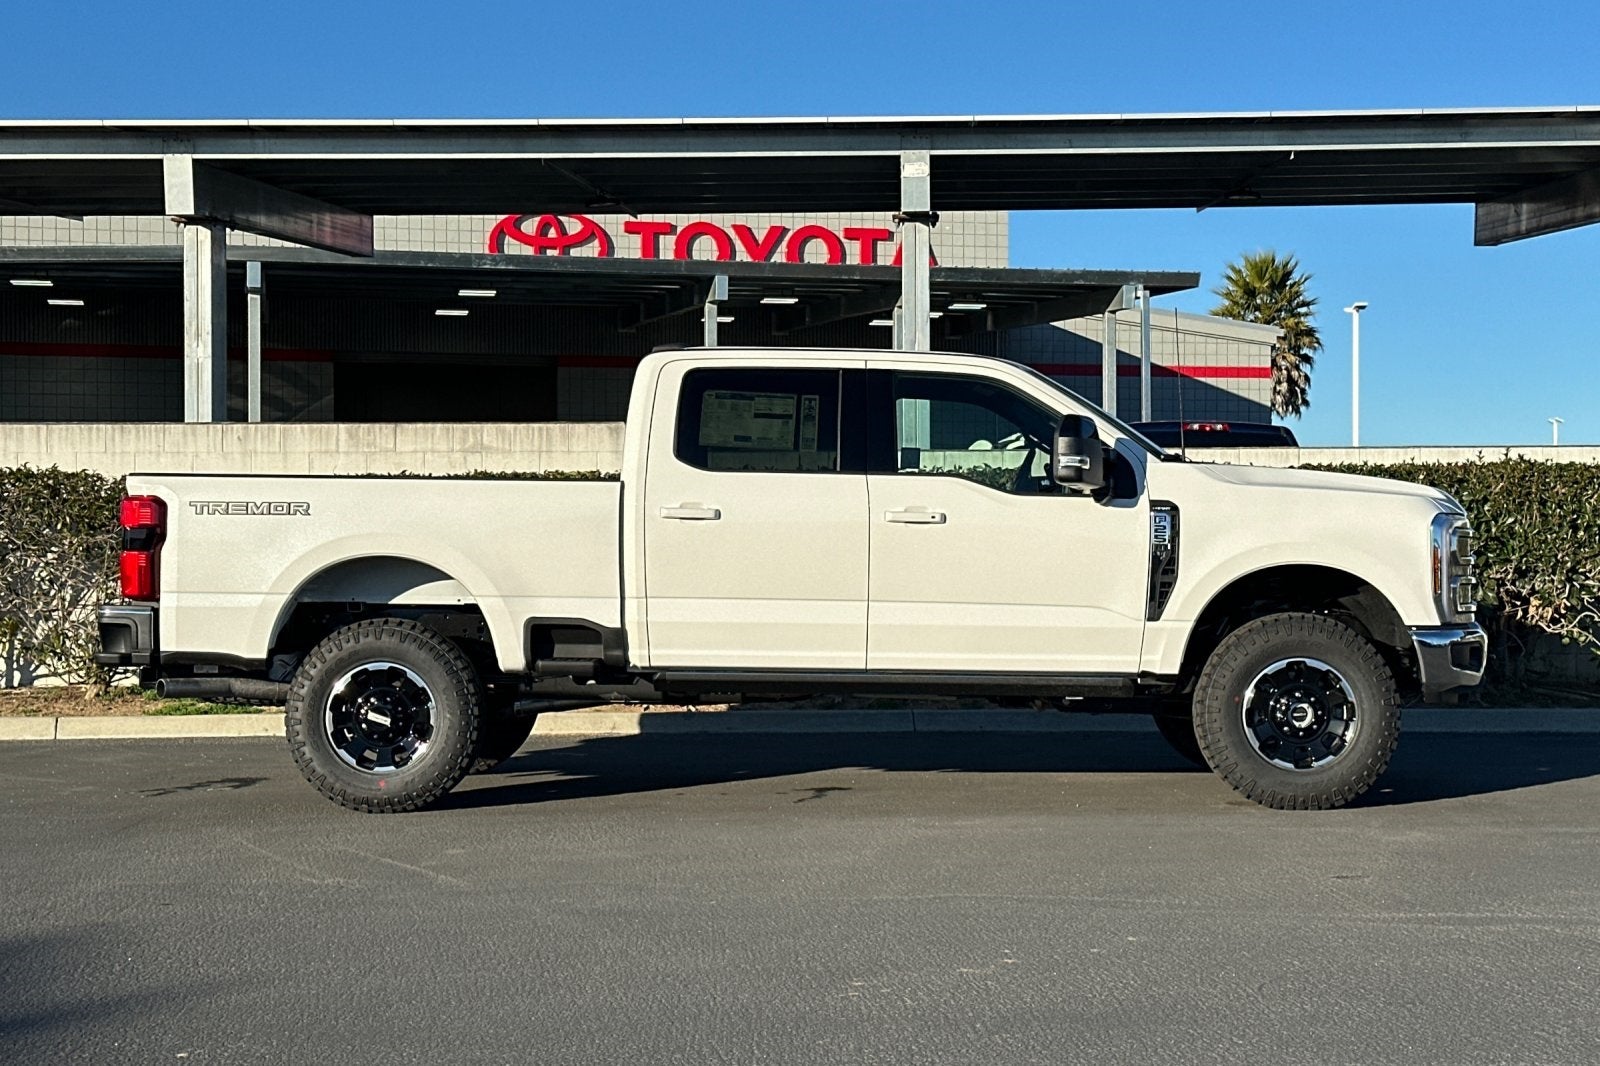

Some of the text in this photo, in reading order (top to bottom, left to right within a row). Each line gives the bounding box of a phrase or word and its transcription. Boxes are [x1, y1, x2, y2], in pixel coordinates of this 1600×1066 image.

[624, 221, 937, 266] TOYOT
[189, 500, 311, 516] TREMOR
[1152, 514, 1168, 555] F25
